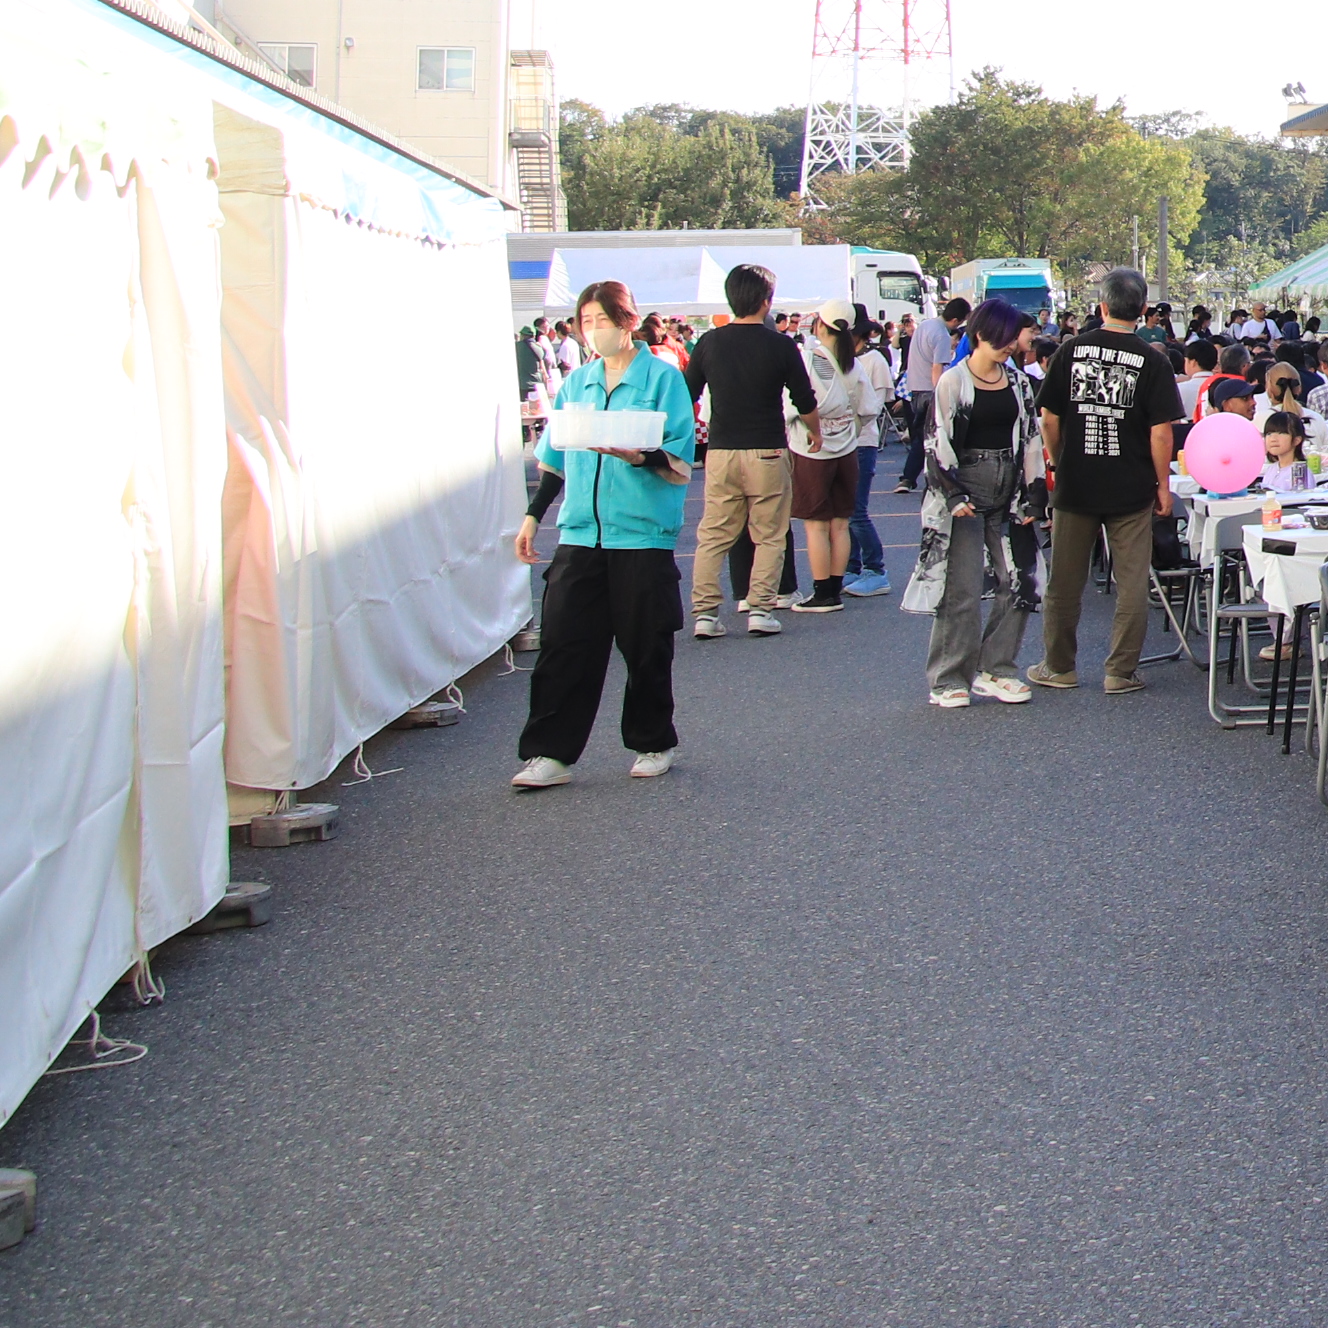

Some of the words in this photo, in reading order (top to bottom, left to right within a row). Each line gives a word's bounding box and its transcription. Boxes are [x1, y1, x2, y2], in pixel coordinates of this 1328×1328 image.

[1073, 345, 1100, 359] LUPIN
[1101, 347, 1117, 363] THE
[1117, 350, 1145, 368] THIRD
